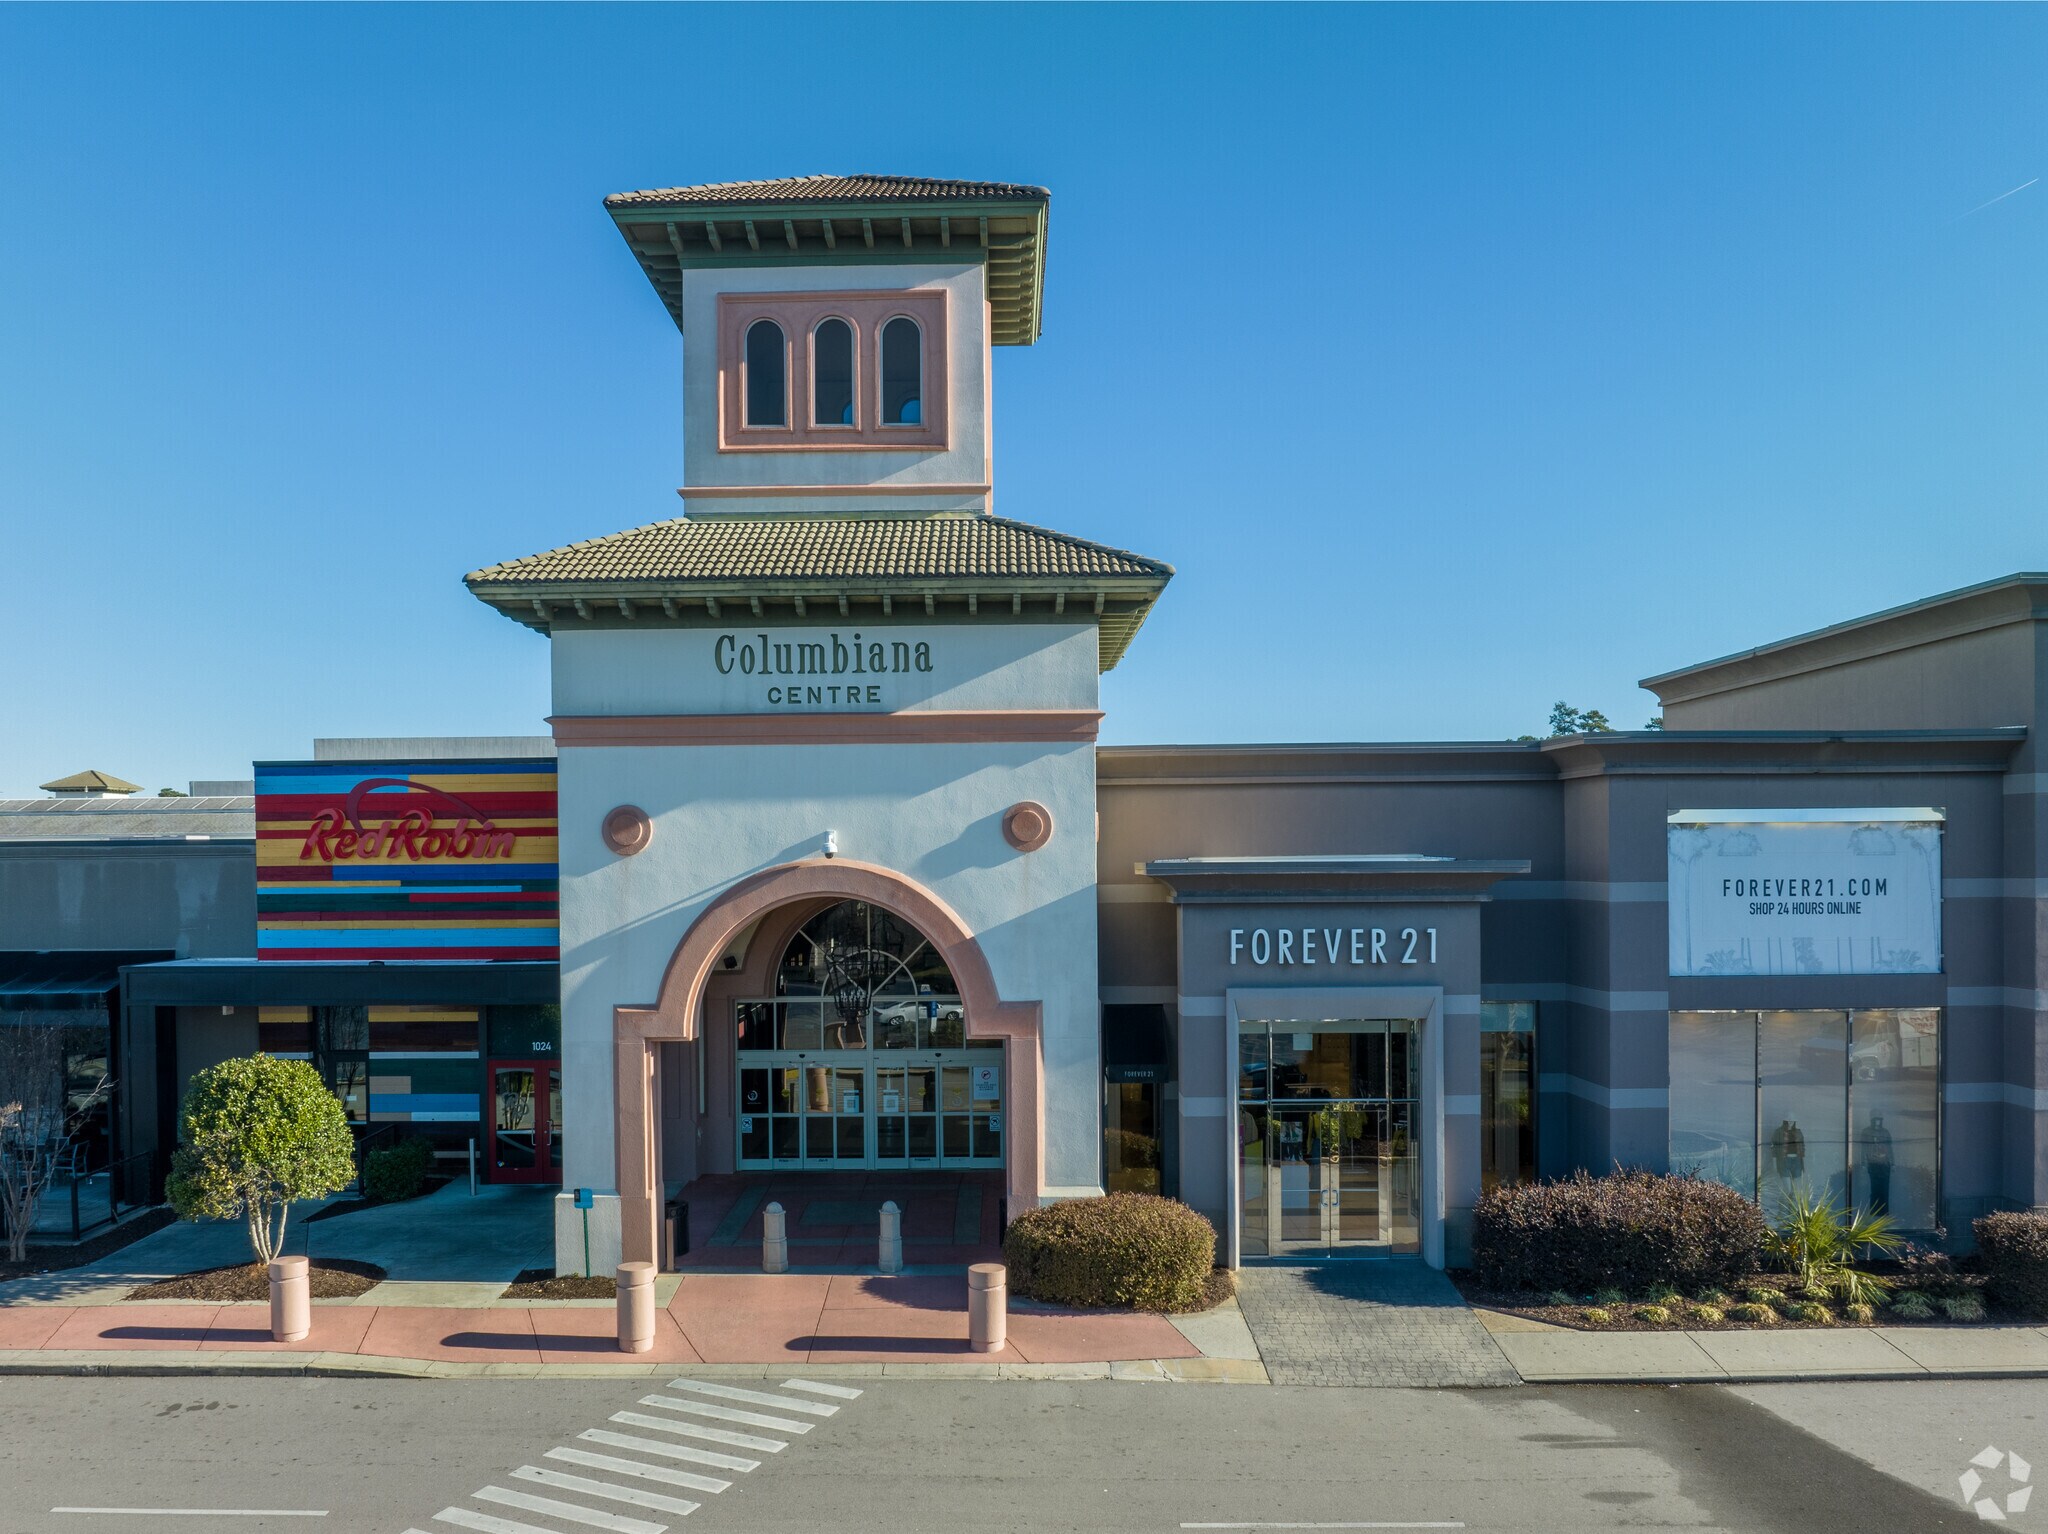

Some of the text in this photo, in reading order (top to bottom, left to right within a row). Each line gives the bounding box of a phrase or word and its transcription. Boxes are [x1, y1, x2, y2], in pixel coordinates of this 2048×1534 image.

[715, 633, 933, 675] Columbiana
[767, 685, 881, 704] CENTRE
[299, 807, 516, 862] Red Robin
[1723, 878, 1887, 897] FOREVER21.COM
[1749, 901, 1861, 915] SHOP 24 HOURS ONLINE
[1230, 928, 1437, 965] FOREVER 21
[532, 1041, 551, 1051] 1024
[1124, 1070, 1147, 1078] FOREVER
